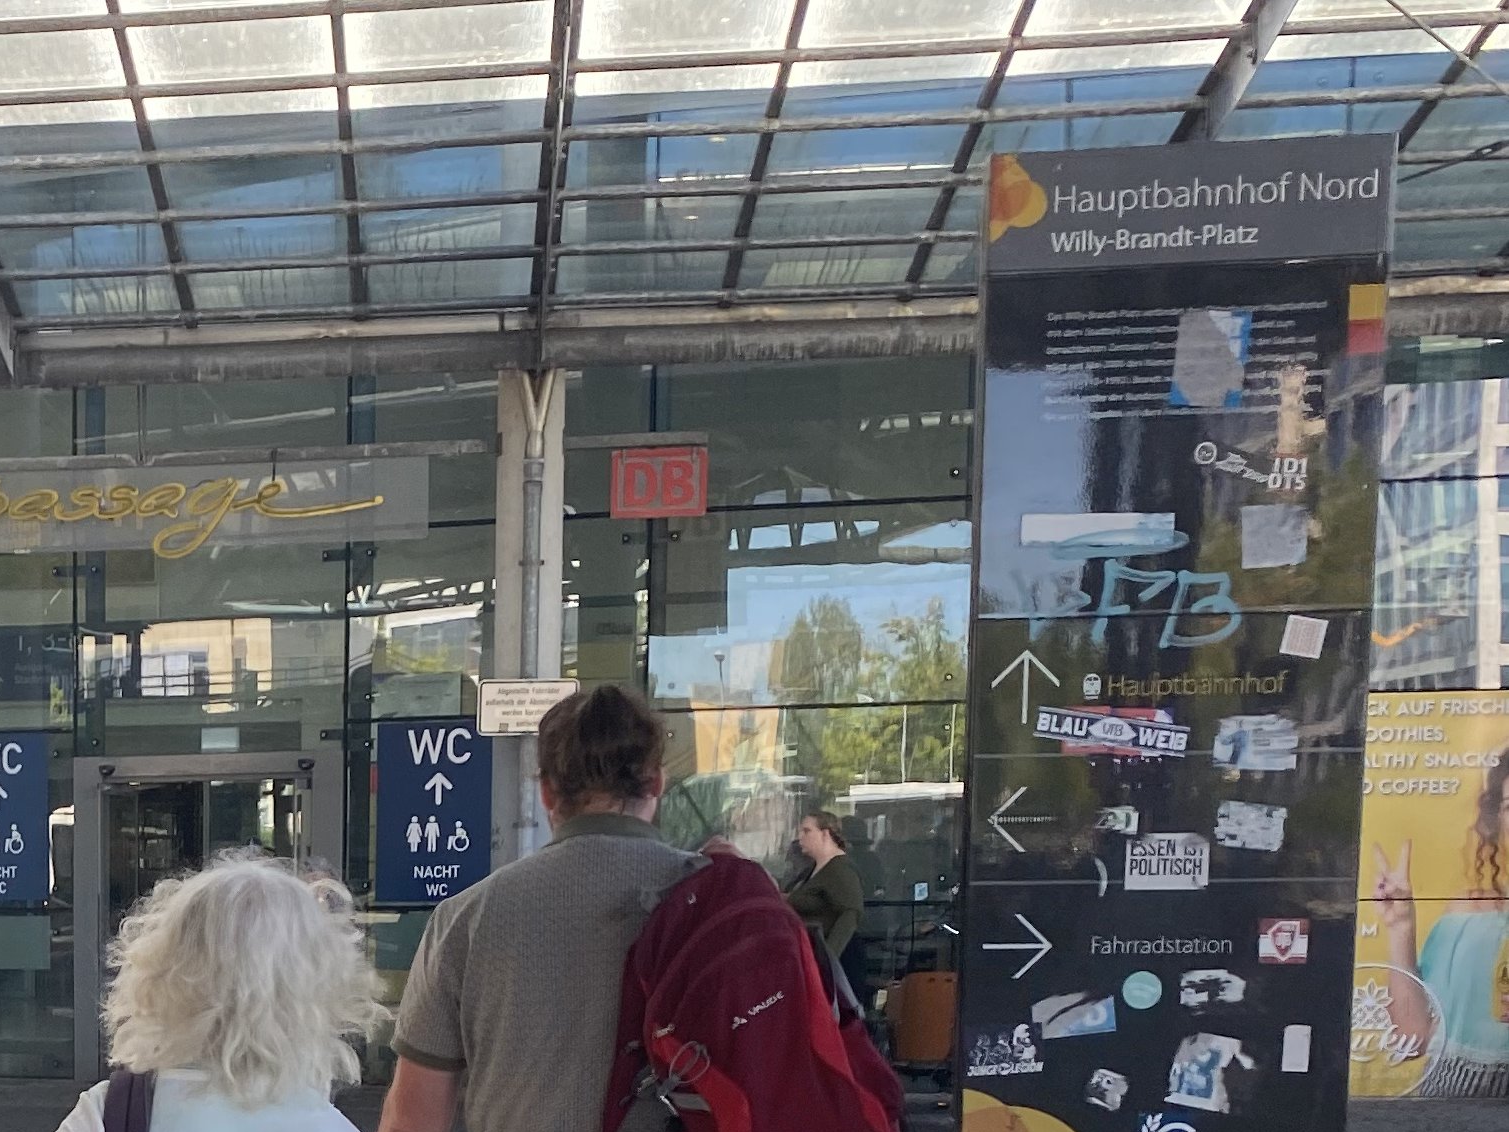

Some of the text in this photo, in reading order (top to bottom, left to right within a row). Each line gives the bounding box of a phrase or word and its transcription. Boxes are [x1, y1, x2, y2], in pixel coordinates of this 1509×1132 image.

[1053, 168, 1380, 218] Hauptbahnhof Nord
[1050, 223, 1259, 257] Willy-Brandt-Platz
[622, 459, 696, 508] DB
[1107, 670, 1289, 700] Hauptbahnhof
[1396, 700, 1435, 716] AUF
[1441, 698, 1509, 716] FRISCH
[1036, 712, 1089, 737] BLAU
[408, 727, 472, 765] WC
[1425, 751, 1500, 768] SNACKS
[1379, 777, 1461, 795] COFFEE?
[1130, 839, 1177, 857] ESSEN
[413, 864, 461, 879] NACHT
[1129, 858, 1203, 877] POLITISCH
[425, 883, 448, 896] WC
[1091, 934, 1233, 954] Fahrradstation
